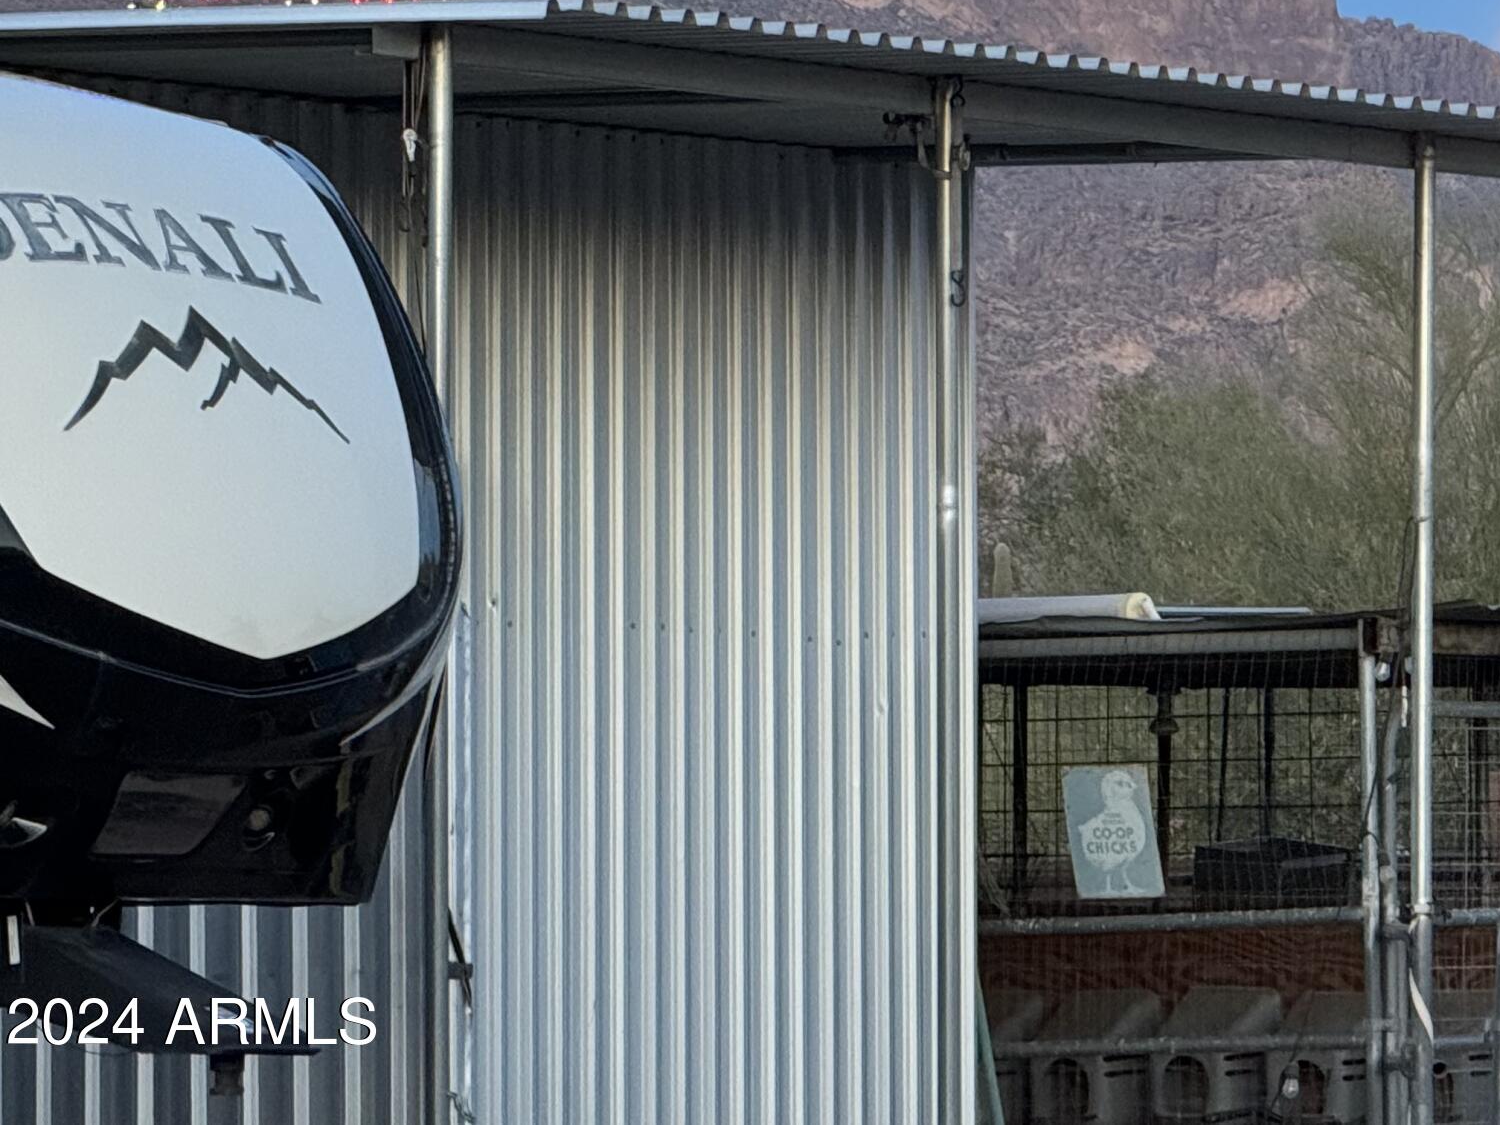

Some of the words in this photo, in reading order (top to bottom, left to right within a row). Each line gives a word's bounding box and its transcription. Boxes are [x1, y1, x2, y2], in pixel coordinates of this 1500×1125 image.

[0, 193, 322, 303] ENALI
[1093, 827, 1134, 840] CO-OP
[1086, 841, 1137, 854] CHICKS
